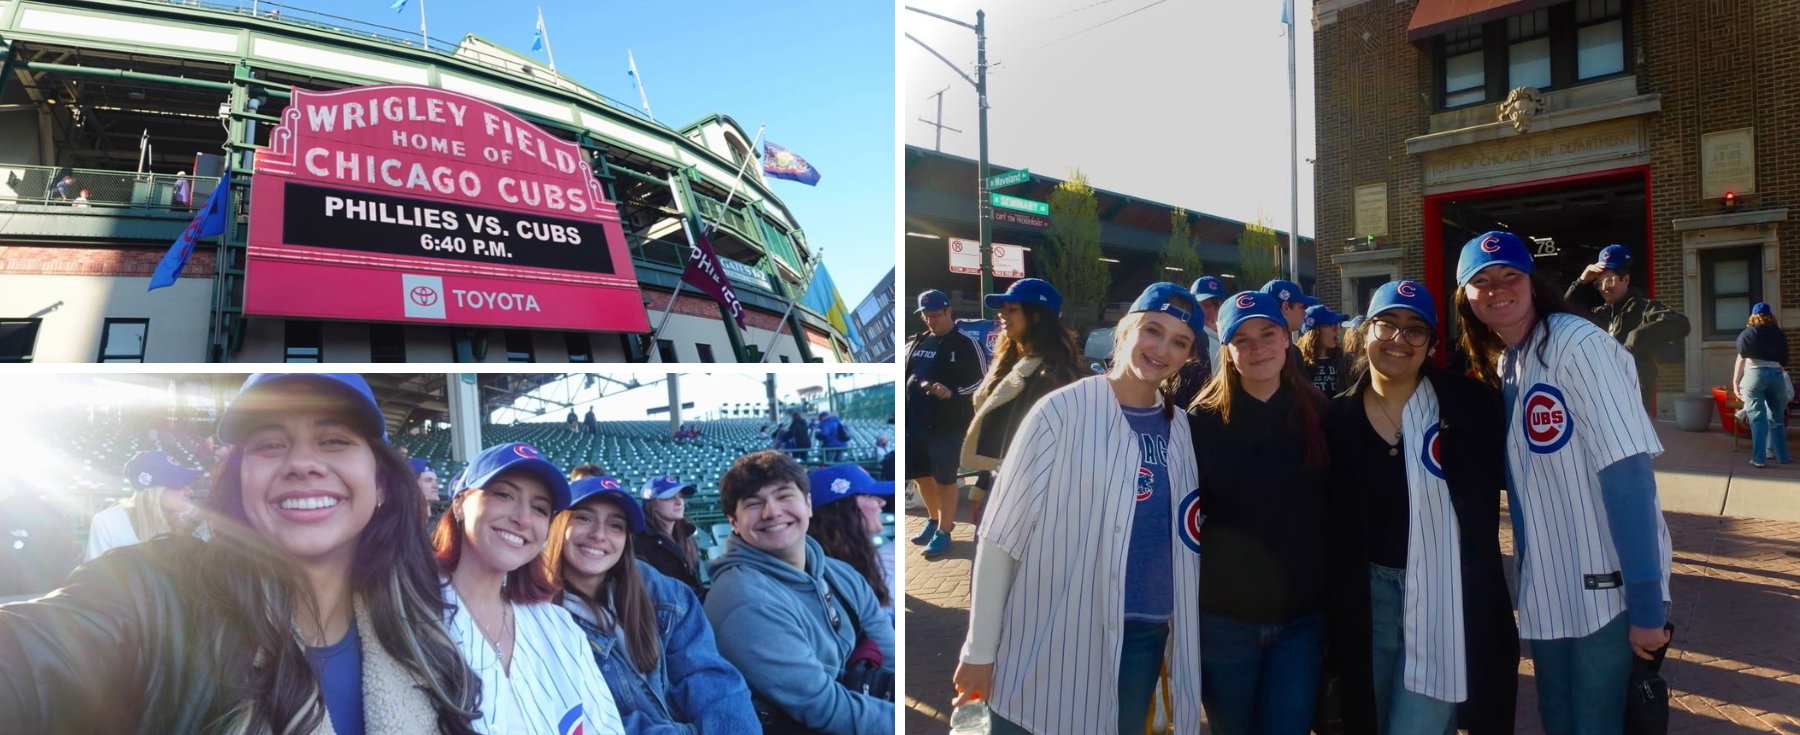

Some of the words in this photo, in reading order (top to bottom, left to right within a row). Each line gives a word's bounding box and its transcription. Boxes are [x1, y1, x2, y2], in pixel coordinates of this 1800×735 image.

[306, 96, 467, 132] WRIGLEY
[483, 111, 576, 174] FIELD
[392, 130, 466, 157] HOME
[483, 147, 512, 164] OF
[1435, 163, 1456, 175] CITY
[1461, 158, 1475, 169] OF
[1480, 150, 1529, 167] CHICAGO
[1534, 146, 1554, 158] FIRE
[1560, 134, 1630, 154] DEPARTMENT
[305, 147, 481, 198] CHICAGO
[498, 177, 587, 213] CUBS
[994, 172, 1021, 187] Waveland
[325, 196, 459, 231] PHILLIES
[465, 213, 509, 236] VS.
[516, 220, 581, 245] CUBS
[420, 234, 466, 253] 6:40
[472, 239, 513, 258] P.M.
[1536, 241, 1555, 254] 78
[720, 258, 752, 276] GATES
[452, 289, 541, 312] TOYOTA
[951, 351, 956, 362] 1
